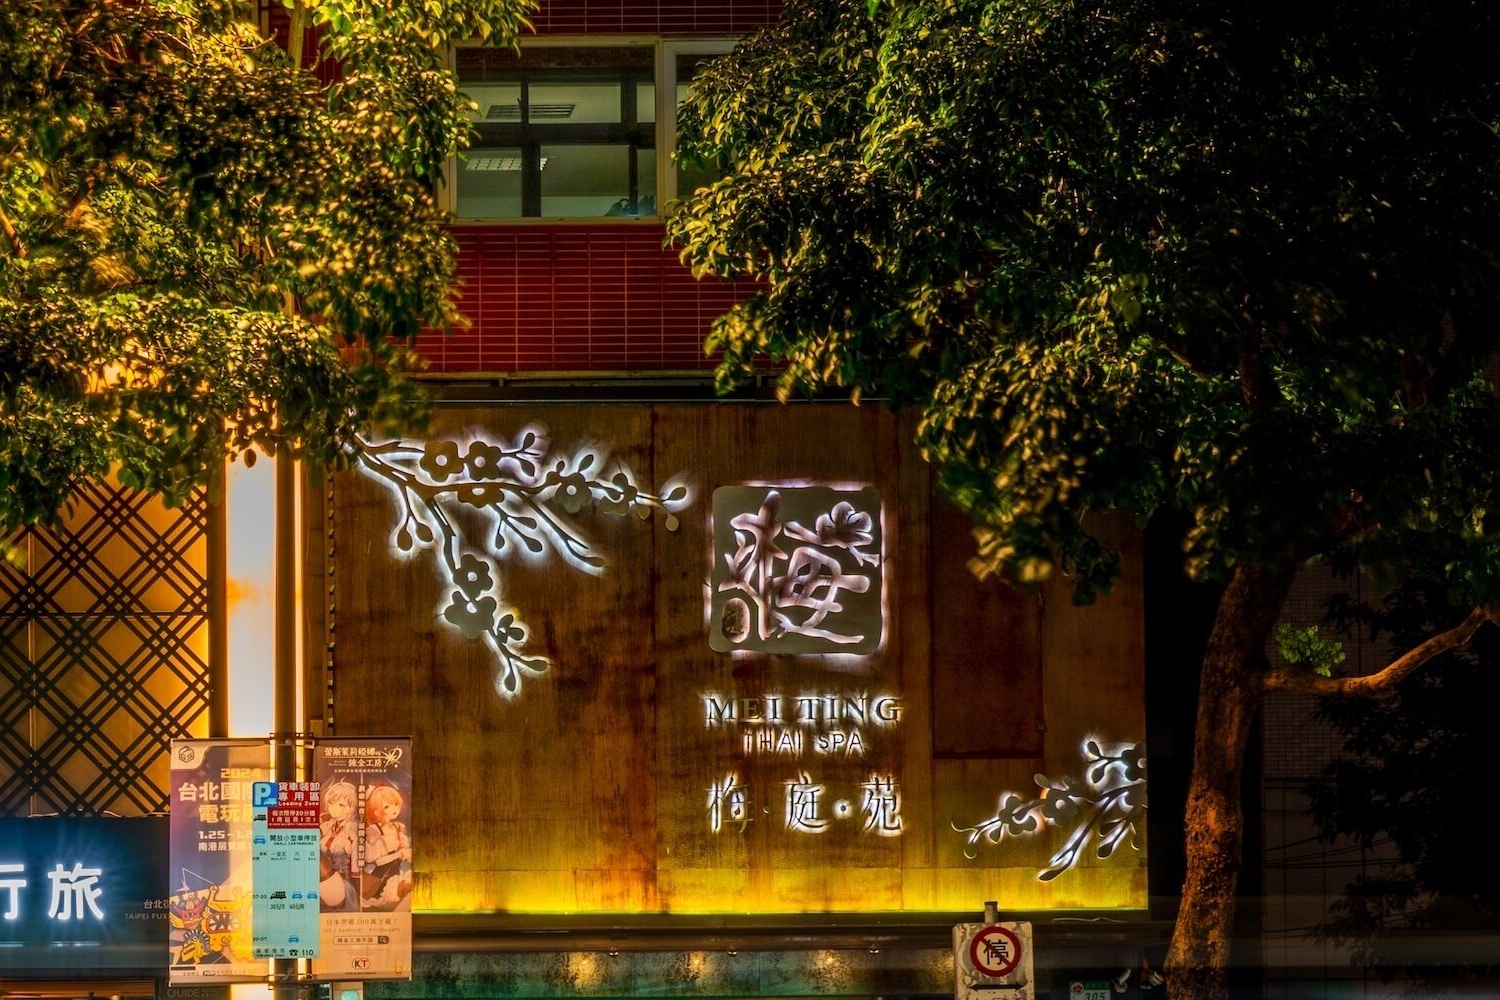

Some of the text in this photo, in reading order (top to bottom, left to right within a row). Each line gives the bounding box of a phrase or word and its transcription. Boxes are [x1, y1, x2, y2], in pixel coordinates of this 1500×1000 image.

[705, 696, 902, 722] MEI TING
[744, 731, 864, 750] THAI SPA
[125, 912, 150, 920] TAIPEI
[354, 960, 367, 968] KT
